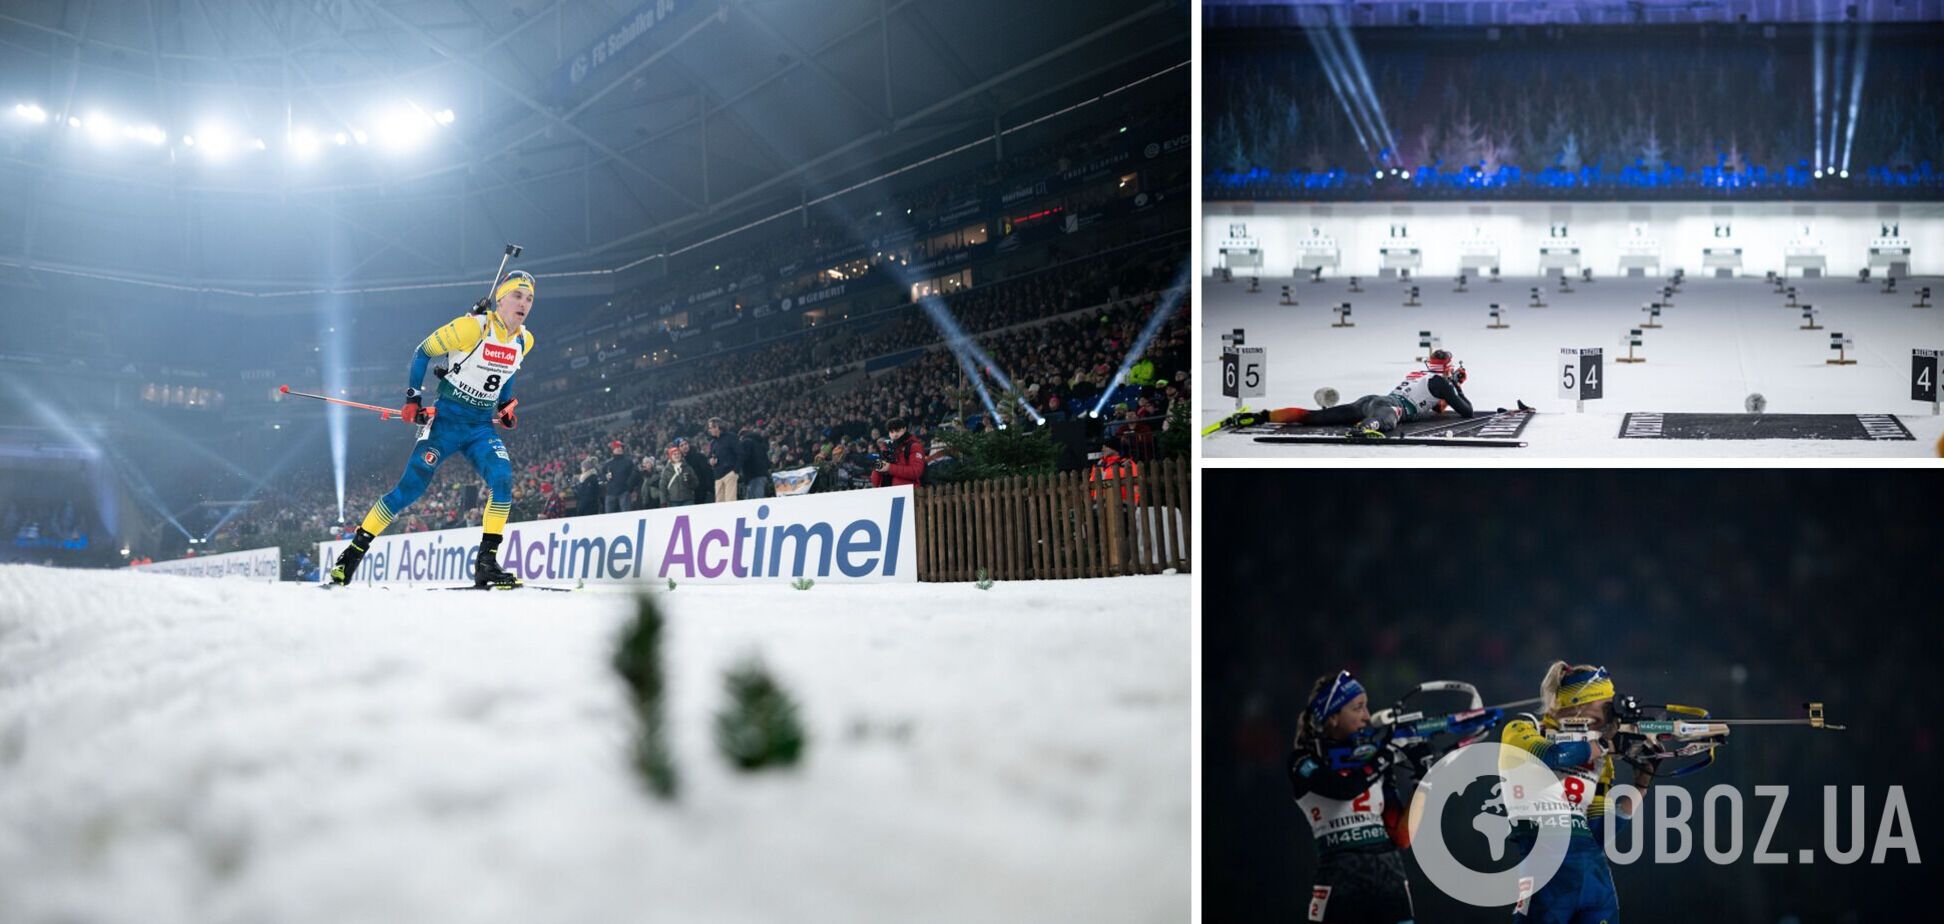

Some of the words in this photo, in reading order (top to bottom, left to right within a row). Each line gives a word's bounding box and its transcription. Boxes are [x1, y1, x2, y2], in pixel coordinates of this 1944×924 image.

[592, 41, 606, 67] FC
[608, 10, 655, 57] Schalke
[807, 285, 846, 304] GEBERIT
[484, 348, 515, 361] bett1.de
[483, 374, 501, 392] 8
[1226, 362, 1236, 388] 6
[1245, 364, 1260, 388] 5
[1563, 364, 1575, 389] 5
[1585, 364, 1598, 389] 4
[1917, 366, 1931, 392] 4
[504, 519, 646, 580] Actimel
[658, 496, 905, 579] Actimel
[396, 534, 481, 581] Actime
[1352, 788, 1371, 813] 2
[1513, 784, 1524, 800] 8
[1563, 776, 1585, 805] 8
[1310, 807, 1321, 822] 2
[1311, 903, 1319, 916] 2
